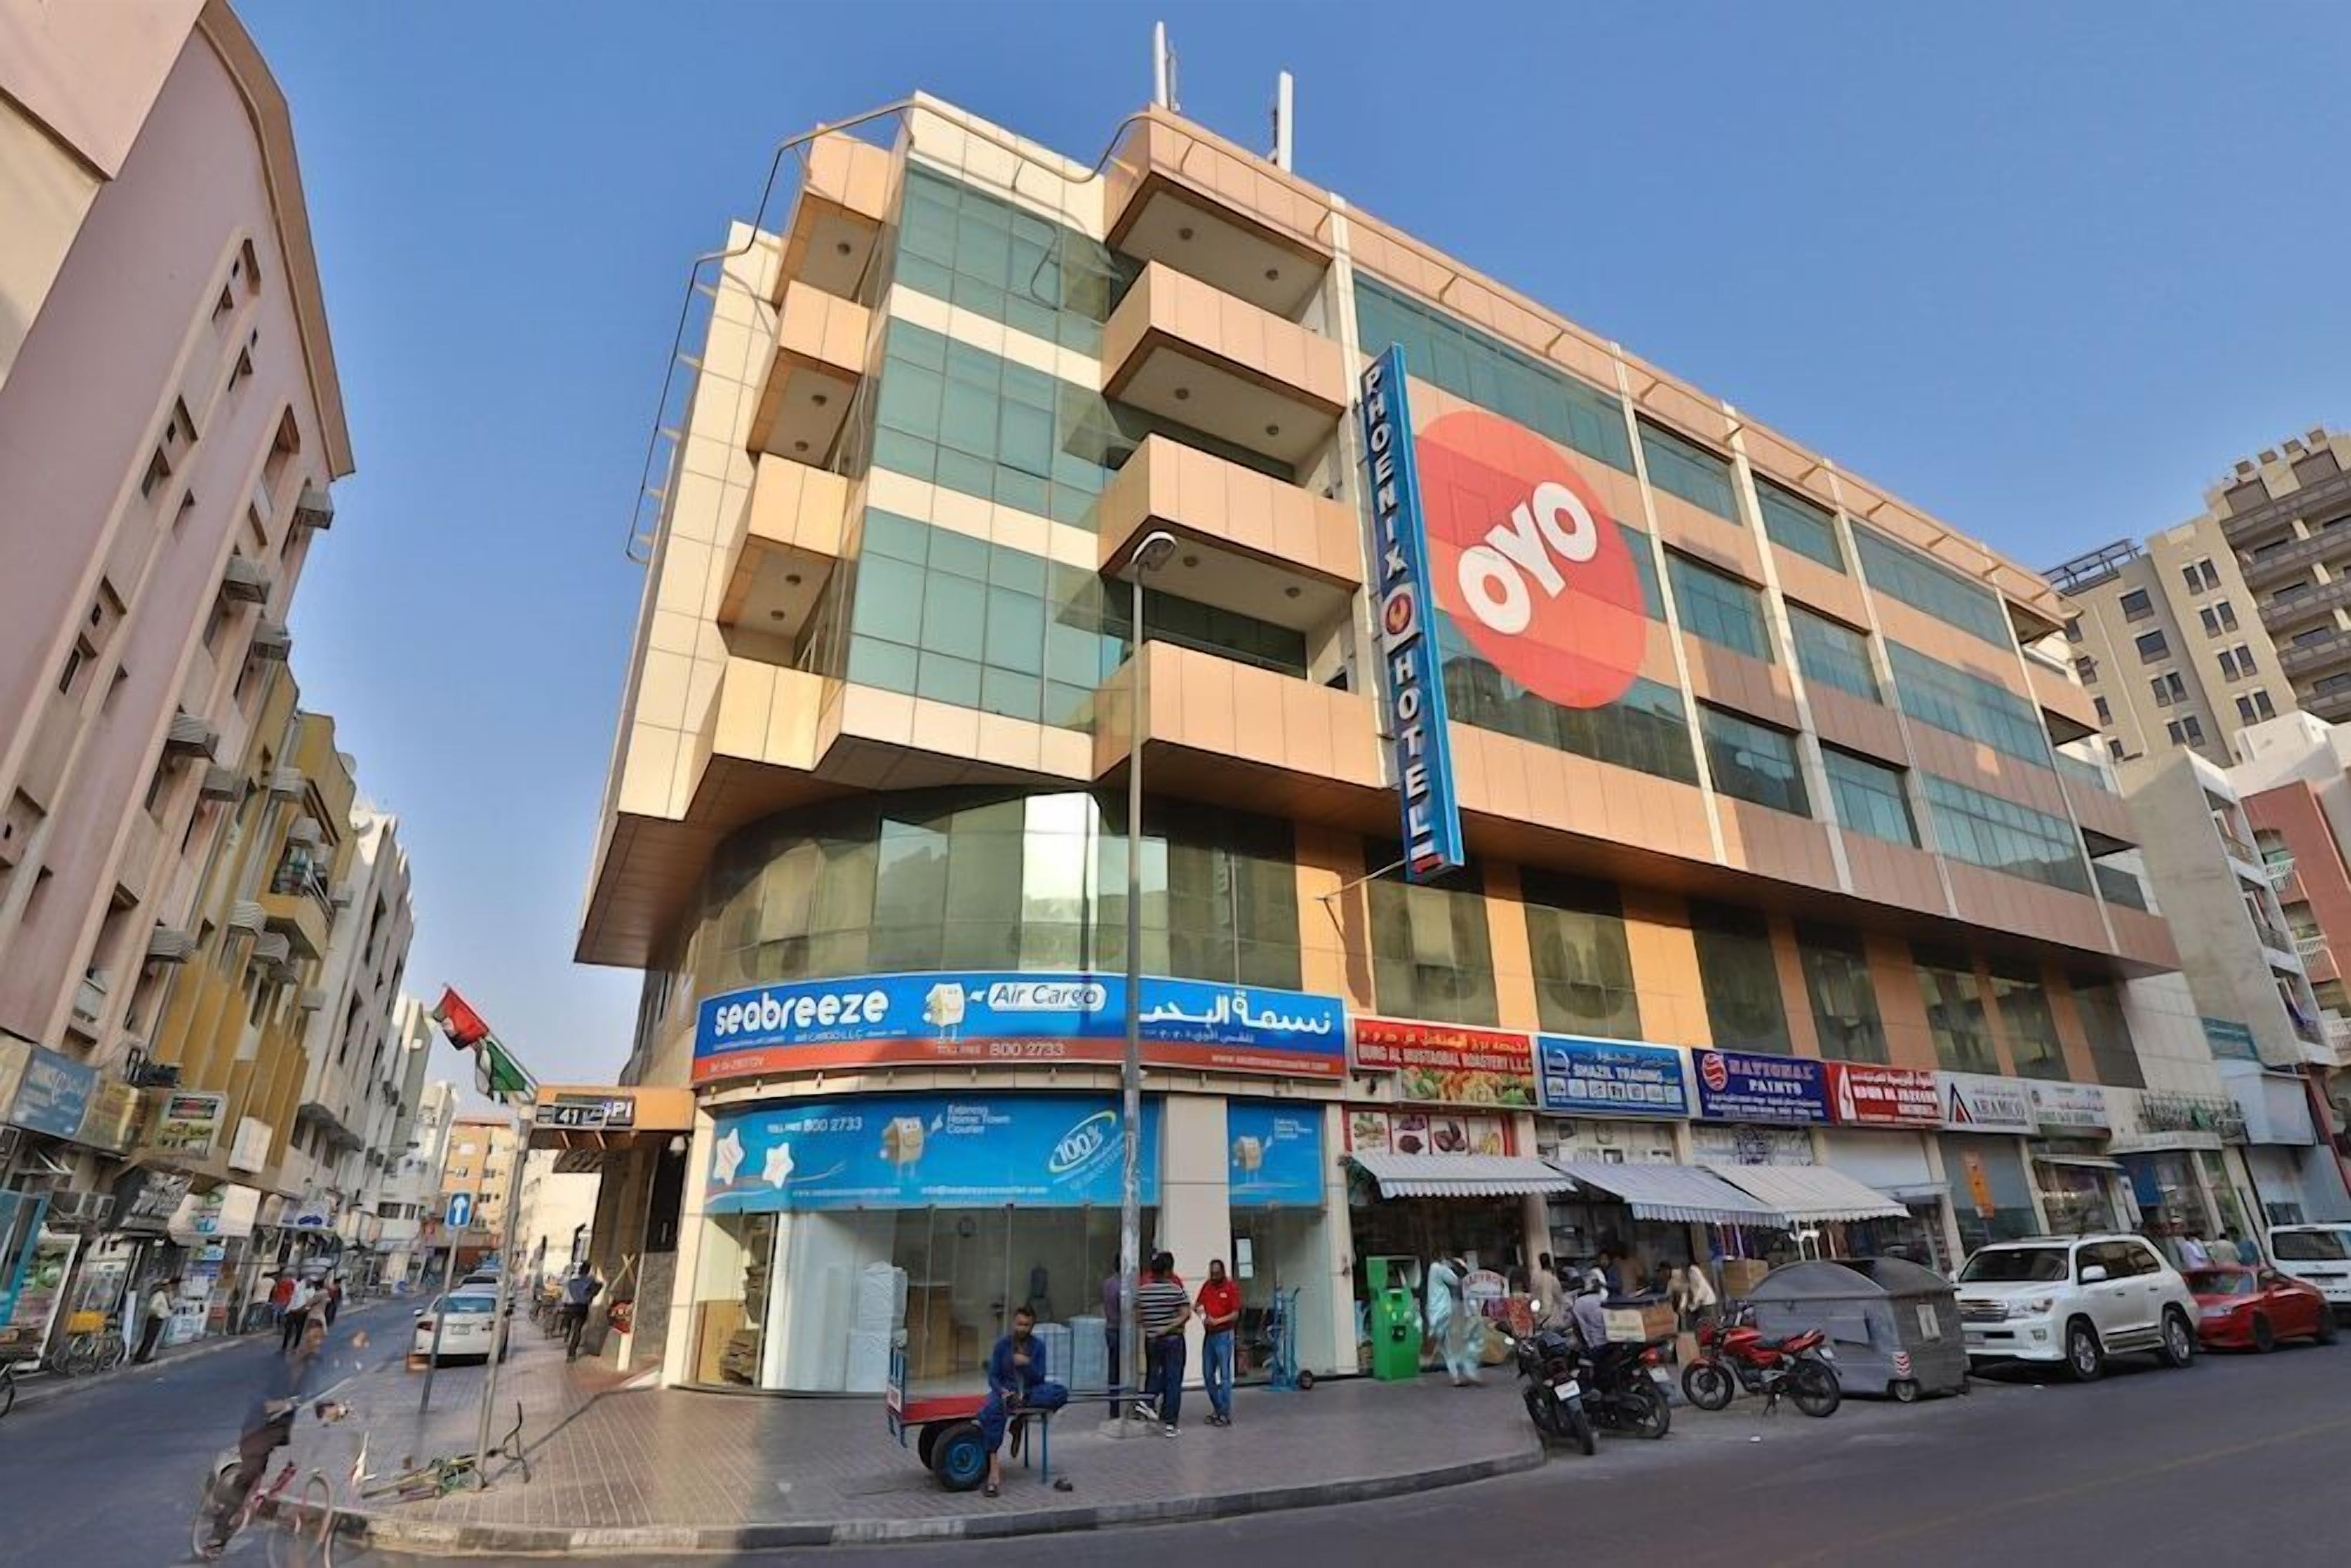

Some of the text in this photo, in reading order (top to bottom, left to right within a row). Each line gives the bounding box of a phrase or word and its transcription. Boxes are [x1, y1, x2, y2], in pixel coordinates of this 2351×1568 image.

[1458, 481, 1598, 635] OYO
[1365, 366, 1431, 838] PHOENIX HOTEL
[994, 984, 1099, 1007] Air Cargo
[714, 990, 889, 1037] seabreeze
[1231, 990, 1332, 1034] نسمة
[989, 1043, 1023, 1056] 800
[1026, 1043, 1066, 1056] 2733
[1728, 1059, 1815, 1081] NATIONAL
[1749, 1078, 1803, 1096] PAINTS
[803, 1118, 828, 1133] 800
[829, 1116, 863, 1132] 2733
